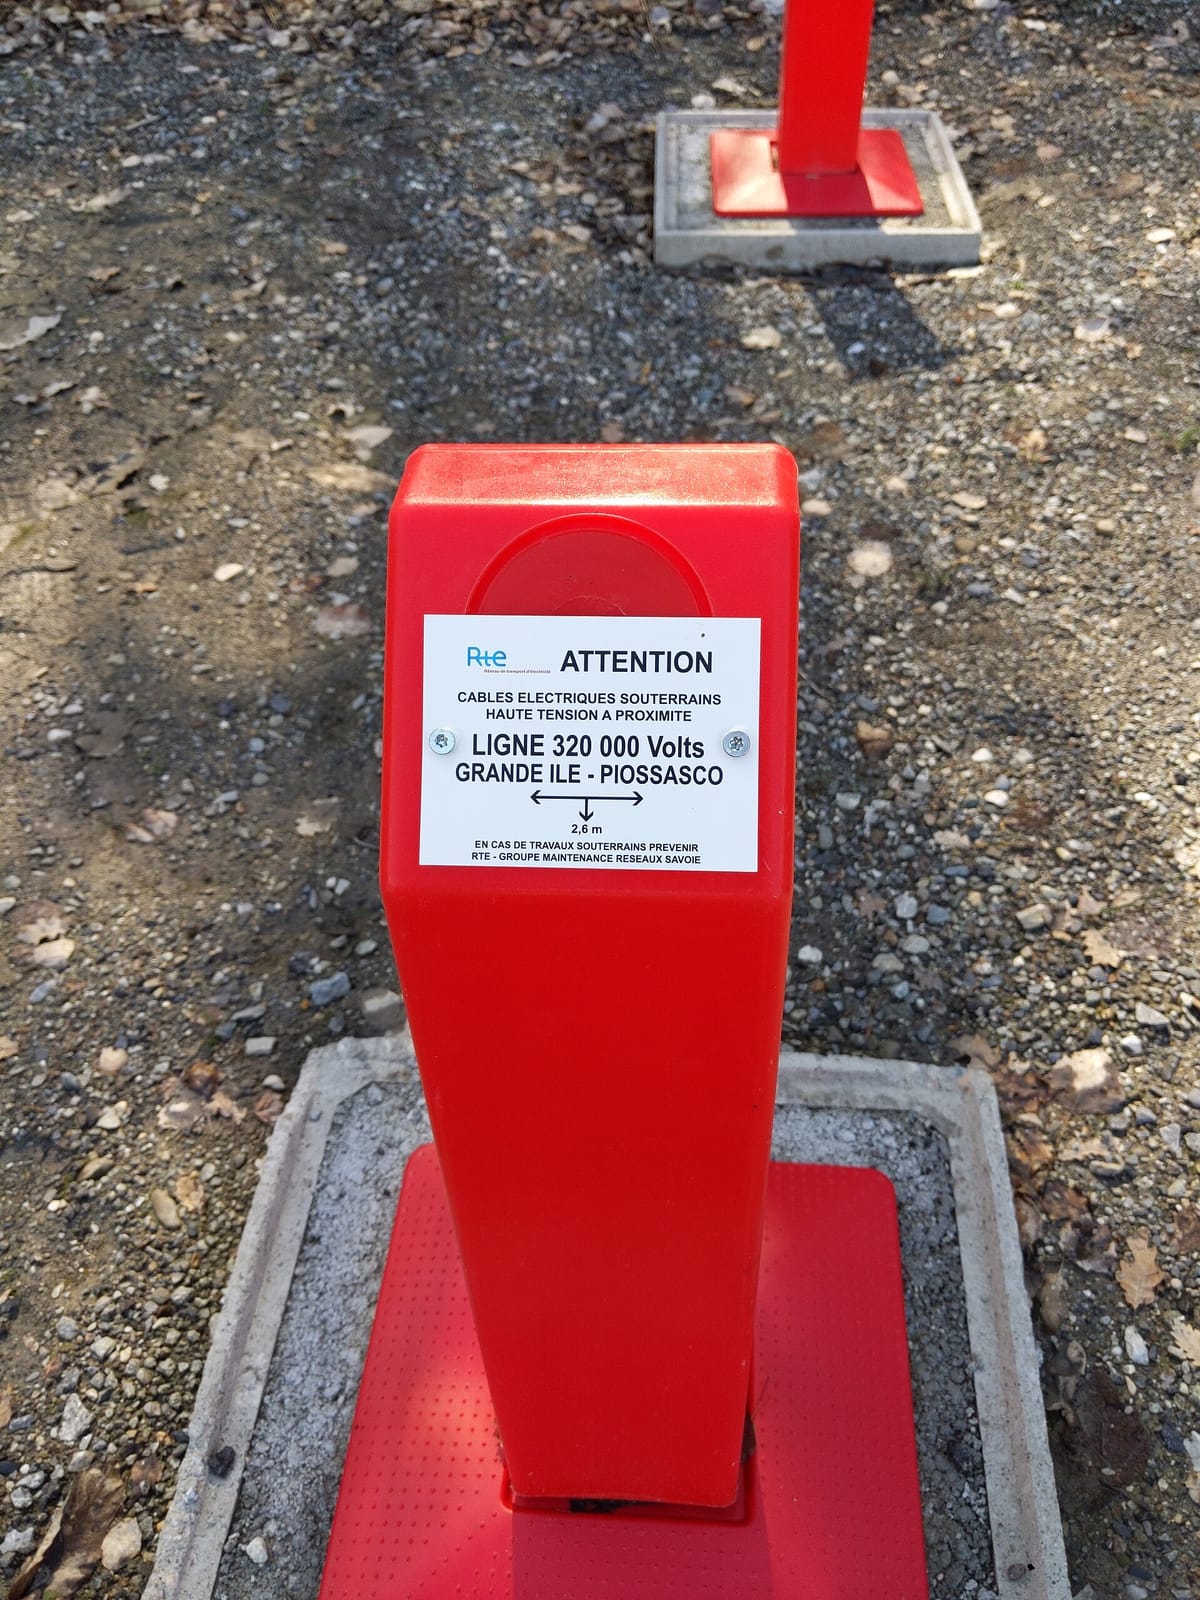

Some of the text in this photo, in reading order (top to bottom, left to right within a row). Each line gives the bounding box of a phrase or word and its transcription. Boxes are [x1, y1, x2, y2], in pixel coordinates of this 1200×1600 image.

[560, 649, 713, 674] ATTENTION
[457, 691, 722, 706] CABLES ELECTRIQUES SOUTERRAINS
[486, 708, 692, 722] HAUTE TENSION A PROXIMITE
[472, 733, 705, 759] LIGNE 320 000 Volts
[455, 762, 544, 783] GRANDE
[549, 764, 581, 784] ILE
[600, 764, 724, 786] PIOSSASCO
[571, 823, 603, 835] 2,6 m
[474, 840, 699, 852] EN CAS DE TRAVAUX SOUTERRAINS PREVENIR
[471, 851, 491, 861] RTE
[499, 852, 540, 861] GROUPE
[542, 853, 614, 863] MAINTENANCE
[616, 854, 663, 863] RESEAUX
[665, 855, 701, 864] SAVOIE
